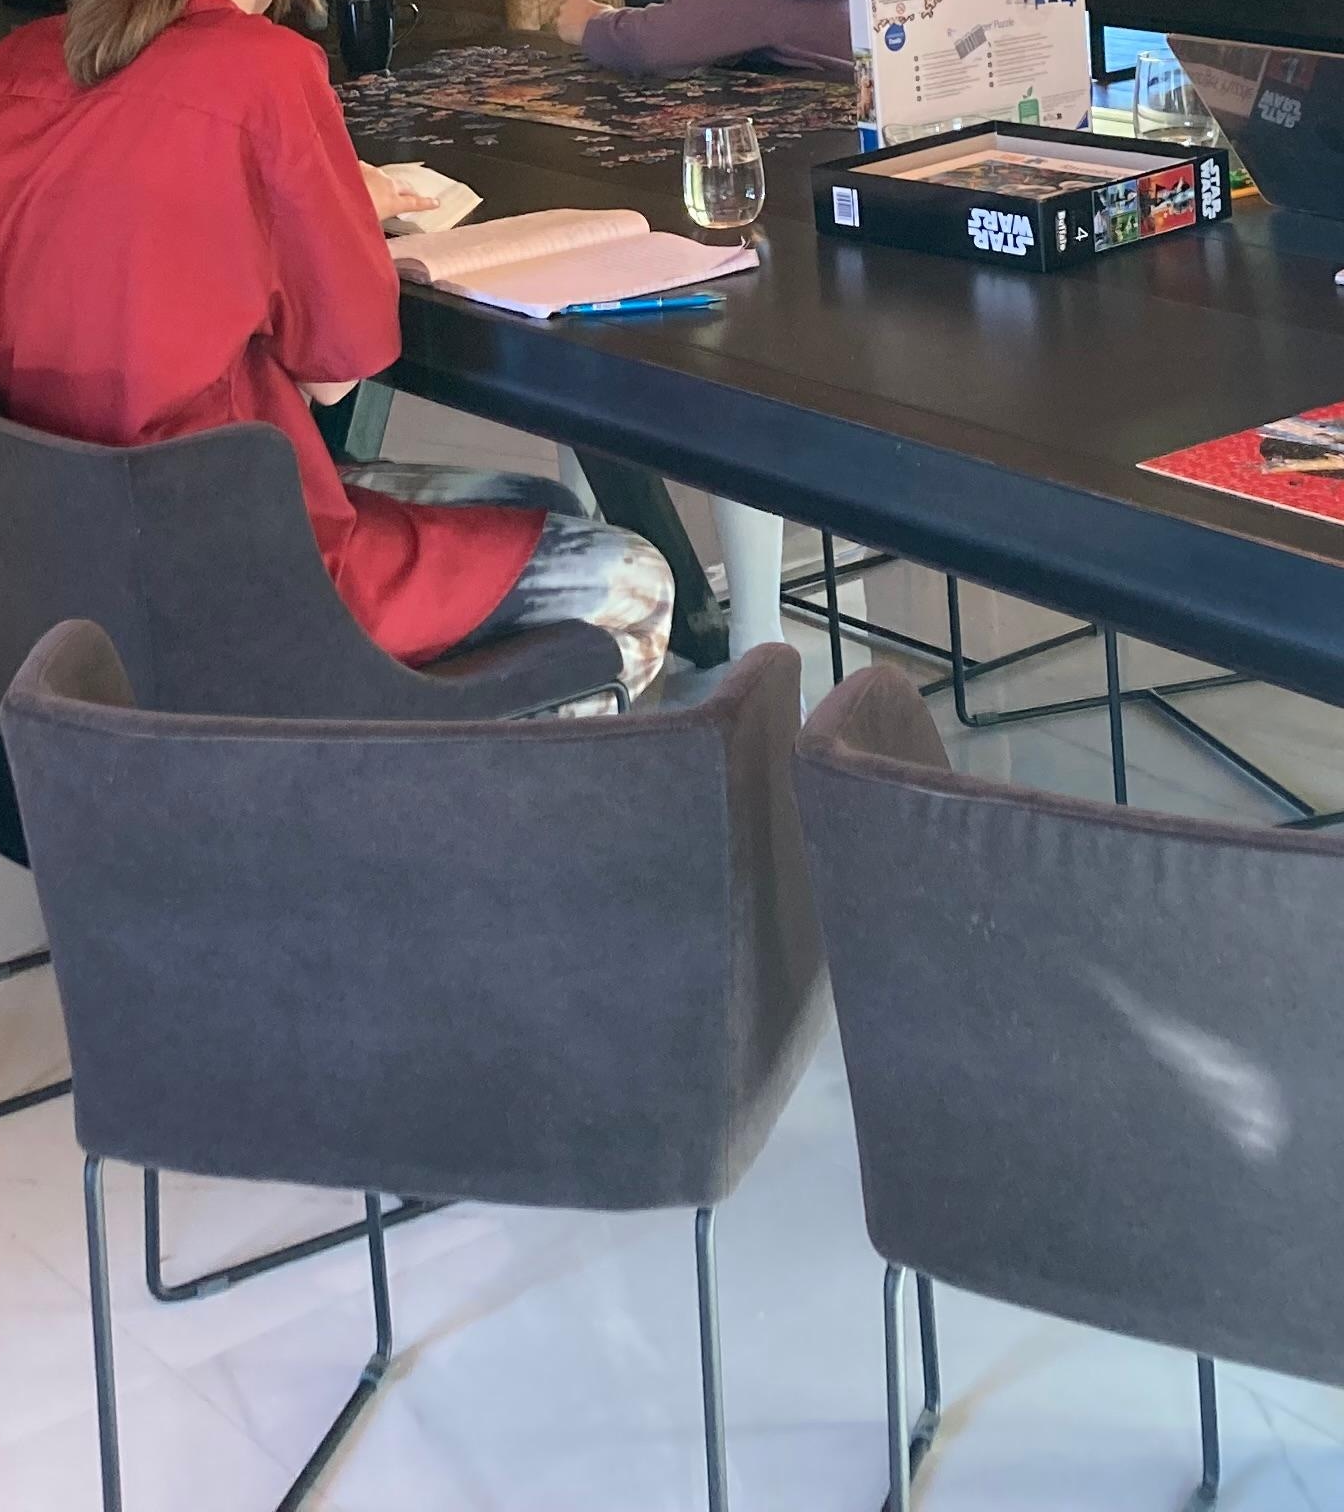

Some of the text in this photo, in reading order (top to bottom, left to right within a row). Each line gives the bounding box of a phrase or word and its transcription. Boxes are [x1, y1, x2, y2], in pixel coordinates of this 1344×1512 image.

[1200, 159, 1213, 219] WARS
[1210, 158, 1222, 219] STAR
[968, 208, 1034, 238] WARS
[1074, 227, 1089, 242] 4
[968, 226, 1034, 256] STAR
